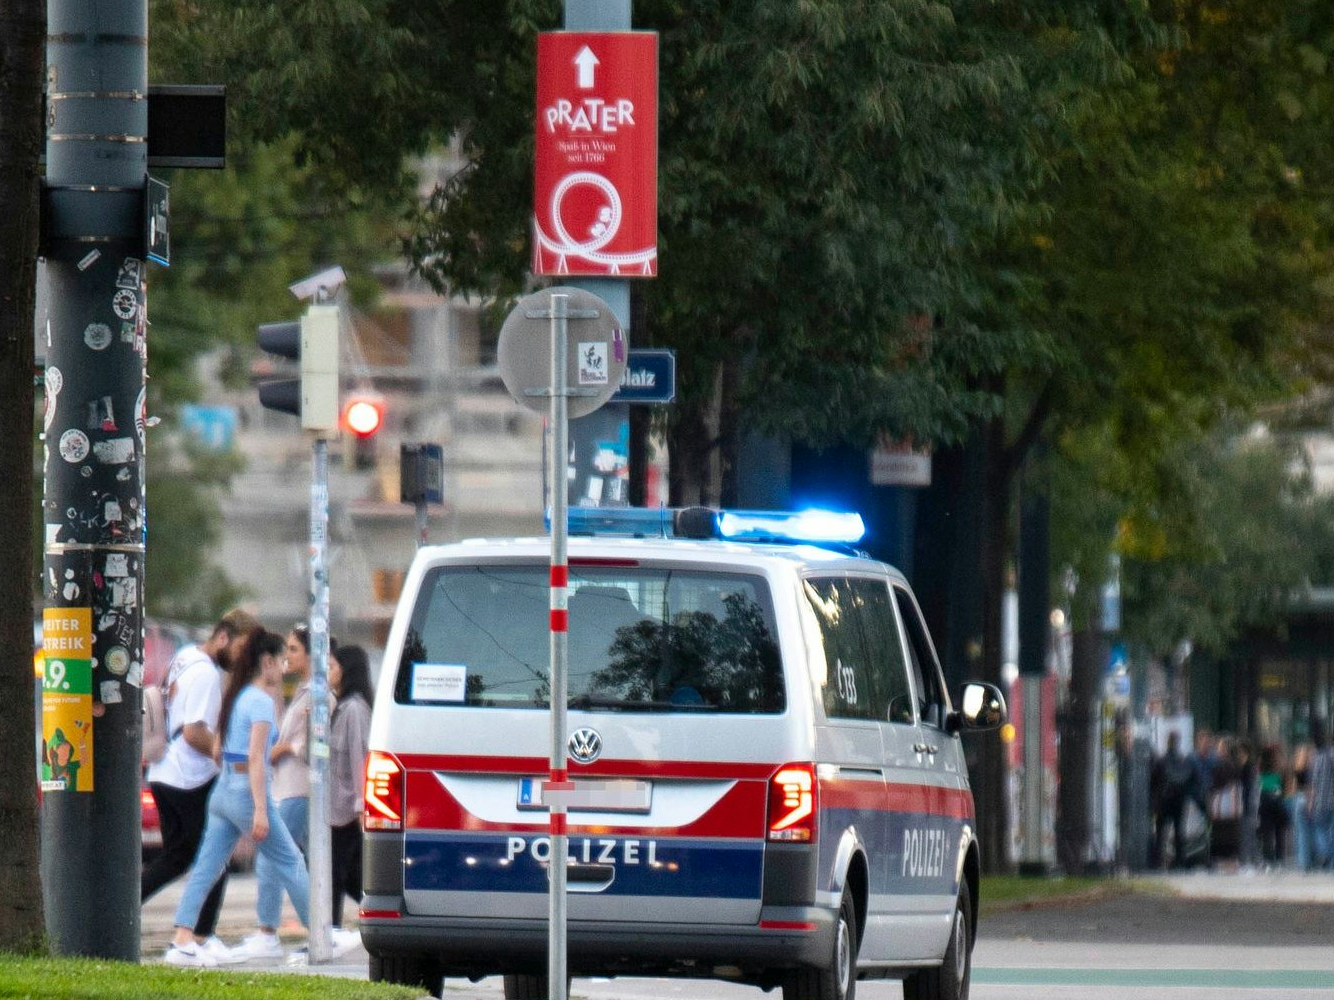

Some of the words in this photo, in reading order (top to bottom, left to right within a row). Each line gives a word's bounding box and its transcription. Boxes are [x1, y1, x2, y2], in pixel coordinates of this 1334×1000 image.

[546, 99, 635, 133] PRATER
[592, 141, 616, 151] Wien
[507, 836, 657, 865] POLIZEI
[902, 829, 945, 877] POLIZEI
